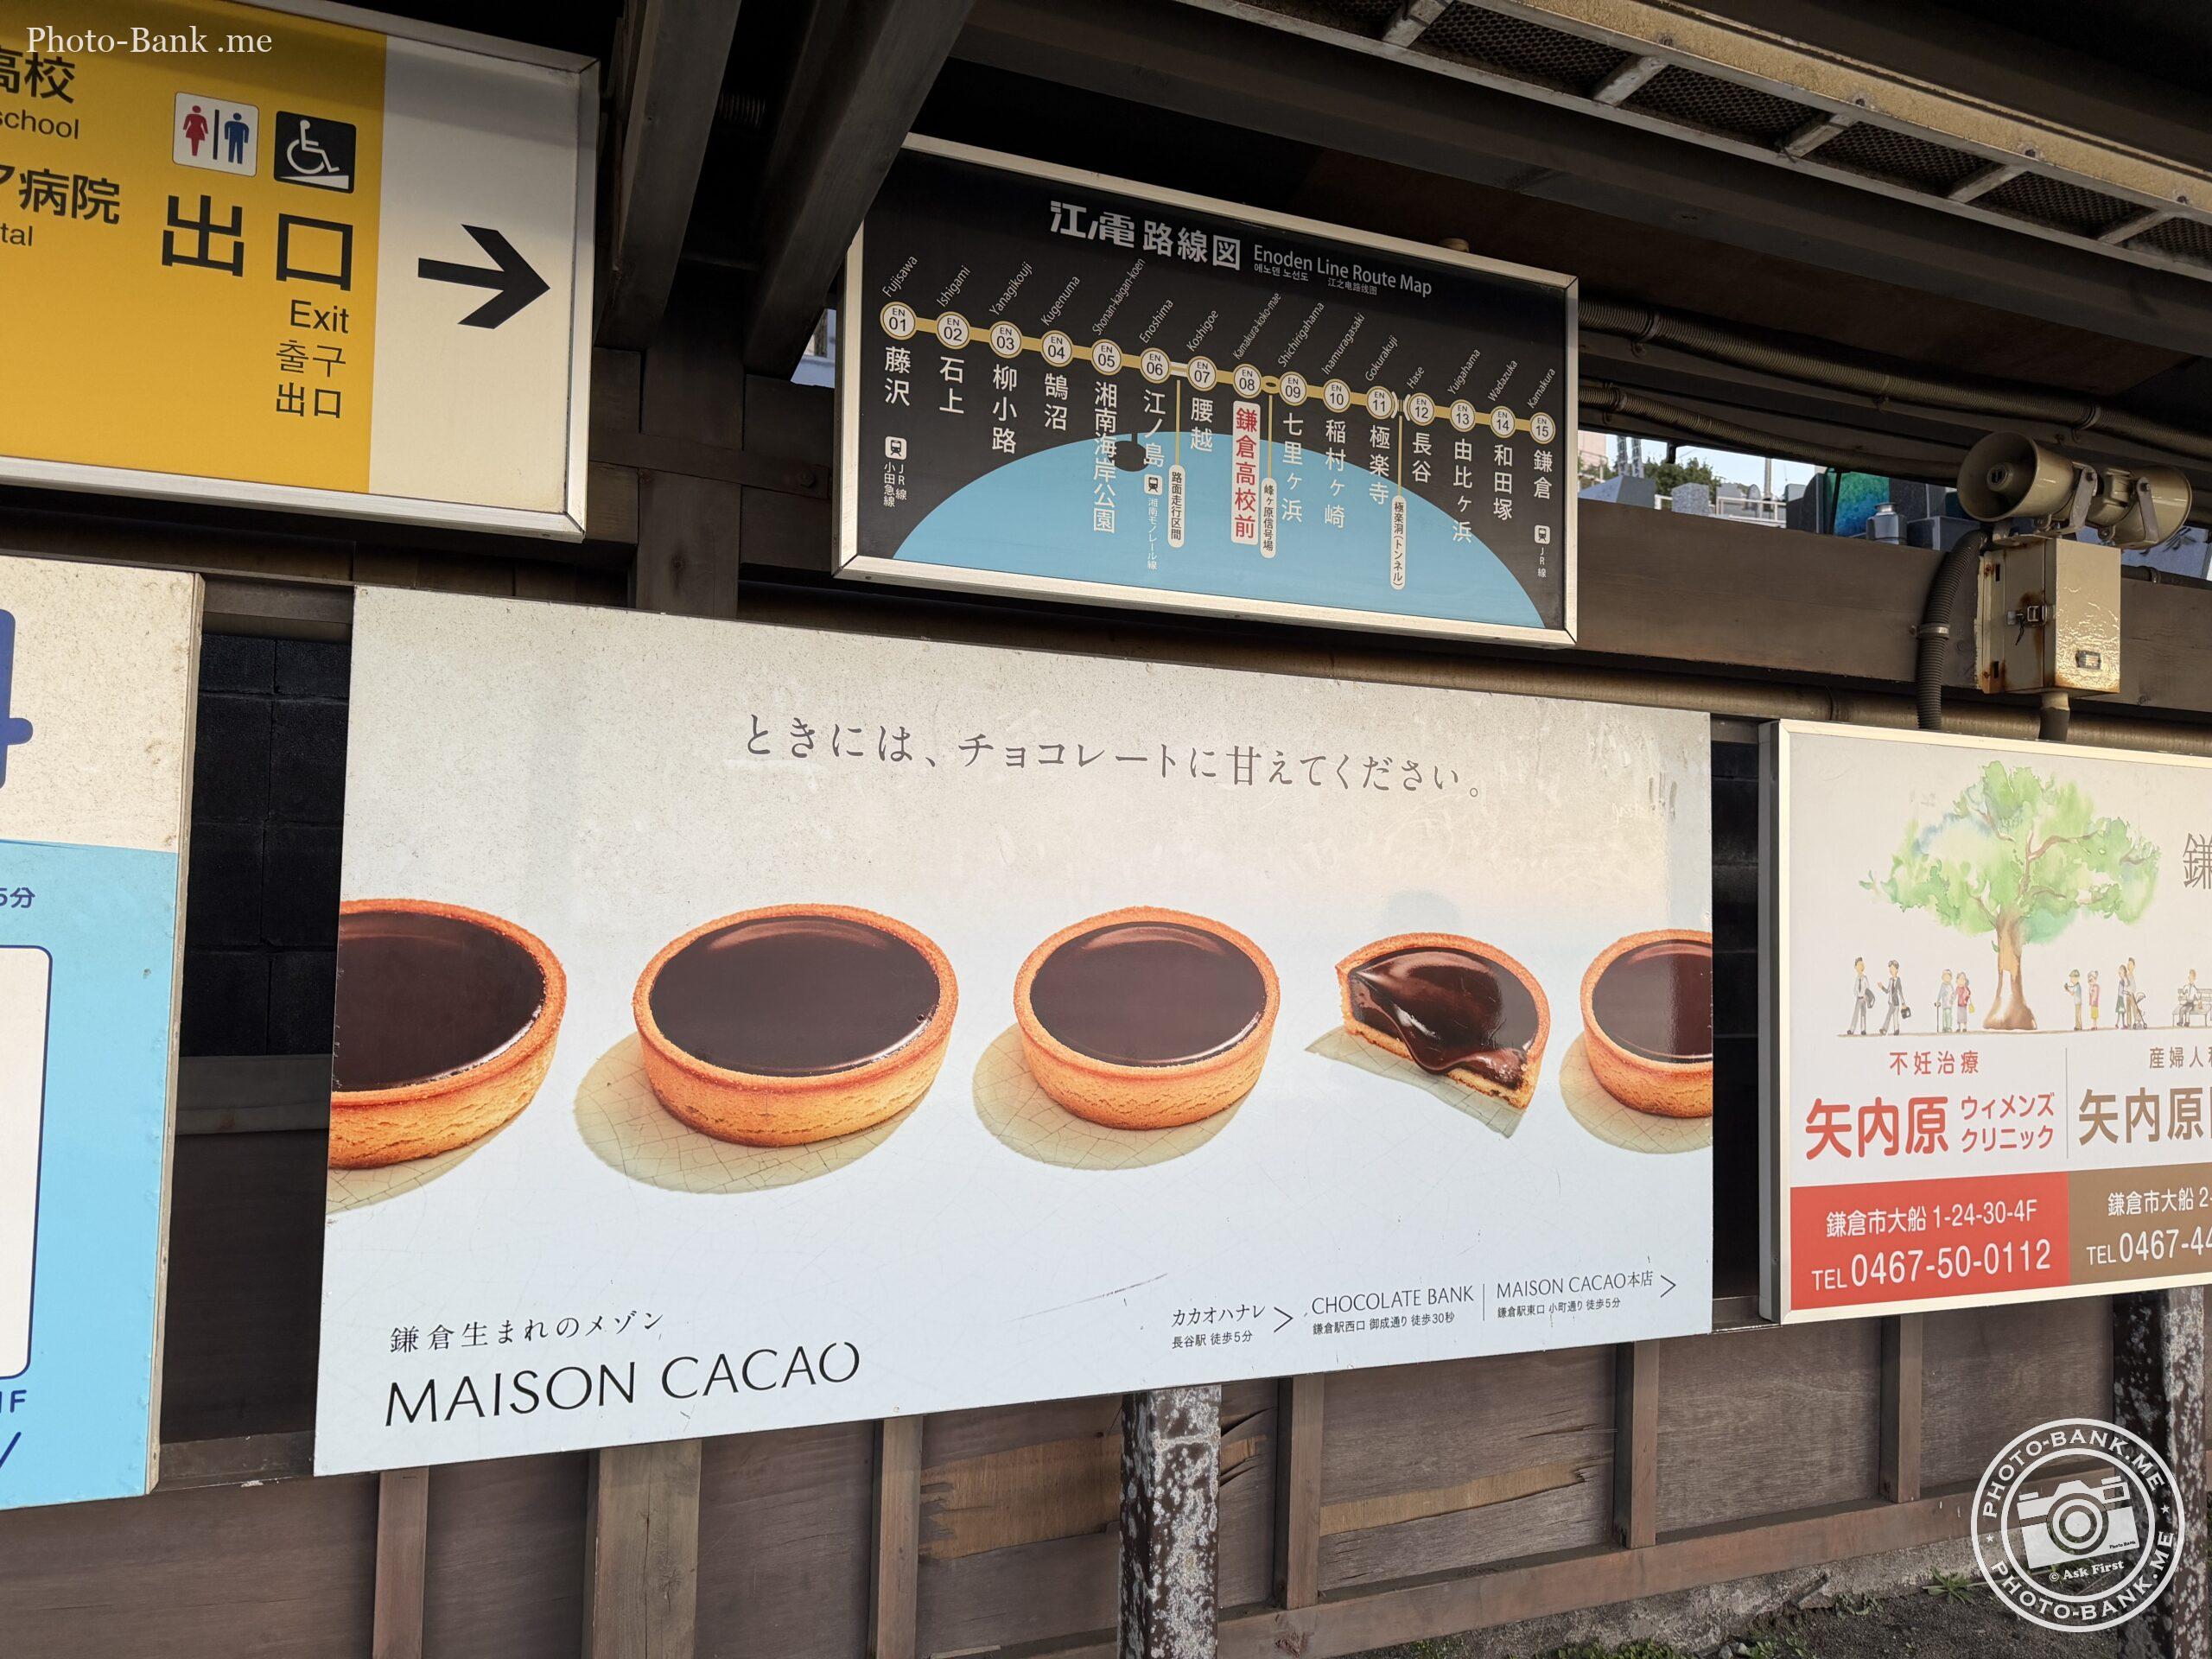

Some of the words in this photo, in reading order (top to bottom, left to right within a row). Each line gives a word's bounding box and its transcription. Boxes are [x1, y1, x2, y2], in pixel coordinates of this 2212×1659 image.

[162, 194, 353, 290] 出口
[882, 256, 918, 298] Fujisawa
[937, 265, 971, 308] Ishigami
[1254, 244, 1313, 271] Enoden
[1317, 257, 1349, 278] Line
[1352, 264, 1396, 288] Route
[1400, 274, 1432, 297] Map
[1282, 268, 1309, 282] 노선도
[988, 261, 1034, 317] Yanagikouji
[1040, 275, 1081, 327] Kugenuma
[1091, 258, 1146, 337] Shonan-kaigan-koen
[289, 298, 350, 334] Exit
[889, 318, 907, 333] 01
[892, 308, 906, 317] EN
[947, 317, 960, 327] EN
[1139, 299, 1173, 343] Enoshima
[1232, 291, 1282, 360] Kamakura-koko-mae
[944, 327, 963, 341] 02
[996, 336, 1014, 351] 03
[1000, 327, 1013, 336] EN
[1051, 336, 1063, 346] EN
[1186, 310, 1219, 352] Koshigoe
[1277, 302, 1325, 368] Shichirigahama
[1320, 312, 1366, 376] Inamuragasaki
[276, 340, 346, 378] 출구
[1047, 346, 1065, 359] 04
[1097, 354, 1116, 368] 05
[1101, 345, 1113, 354] EN
[1149, 353, 1160, 363] EN
[1364, 335, 1398, 382] Gokurakuji
[885, 346, 911, 407] 藤沢
[939, 356, 965, 415] 石上
[1147, 363, 1163, 377] 06
[1194, 371, 1210, 384] 07
[1239, 378, 1255, 391] 08
[1242, 369, 1253, 378] EN
[1287, 377, 1298, 385] EN
[1331, 384, 1342, 392] EN
[1407, 365, 1426, 390] Hase
[1446, 348, 1482, 395] Yuigahama
[1487, 359, 1518, 403] Wadazuka
[276, 381, 341, 419] 出口
[1044, 372, 1069, 431] 鵠沼
[1285, 385, 1301, 398] 09
[1328, 392, 1344, 405] 10
[1372, 399, 1387, 411] 11
[1374, 391, 1385, 400] EN
[1416, 397, 1427, 406] EN
[1527, 367, 1556, 410] Kamakura
[992, 364, 1018, 454] 柳小路
[1190, 397, 1213, 452] 腰越
[1414, 406, 1429, 418] 12
[1455, 412, 1470, 424] 13
[1496, 419, 1510, 431] 14
[1143, 389, 1166, 467] 江ノ島
[1535, 424, 1549, 437] 15
[1093, 381, 1118, 534] 湘南海岸公園
[1234, 407, 1258, 539] 鎌倉高校前
[1369, 424, 1390, 505] 極楽寺
[1411, 432, 1433, 483] 長谷
[1533, 449, 1553, 499] 鎌倉
[884, 461, 895, 507] 小田急線
[895, 463, 907, 501] JR線
[1493, 444, 1513, 520] 和田塚
[1171, 472, 1183, 541] 路面走行区間
[1537, 548, 1547, 578] JR線
[747, 714, 1478, 798] ときには、チョコレートに甘えてください。
[1889, 1050, 1980, 1076] 不妊治療
[1961, 1091, 2056, 1122] ウィメンズ
[2079, 1087, 2212, 1147] 矢内原
[1805, 1096, 1948, 1160] 矢内原
[1961, 1124, 2055, 1154] クリニック
[1826, 1206, 1927, 1238] 鎌倉市大船
[1932, 1199, 2038, 1230] 1-24-30-4F
[2108, 1187, 2194, 1216] 鎌倉市大船
[2199, 1186, 2212, 1208] 2
[1811, 1269, 1847, 1292] TEL
[1851, 1239, 2050, 1287] 0467-50-0112
[2086, 1244, 2116, 1265] TEL
[1312, 1289, 1421, 1314] CHOCOLATE
[1427, 1285, 1474, 1305] BANK
[1497, 1279, 1563, 1299] MAISON
[1171, 1304, 1266, 1328] カカオハナレ
[1313, 1319, 1365, 1336] 鎌倉駅西口
[1370, 1316, 1407, 1330] 御成通り
[1411, 1311, 1455, 1327] 徒歩30秒
[1497, 1304, 1545, 1319] 鎌倉駅東口
[1548, 1300, 1582, 1314] 小町通り
[1586, 1297, 1621, 1311] 徒歩5分
[389, 1310, 664, 1354] 鎌倉生まれのメゾン
[1172, 1333, 1207, 1350] 長谷駅
[1211, 1330, 1253, 1345] 徒歩5分
[385, 1362, 635, 1426] MAISON
[661, 1341, 860, 1399] CACAO
